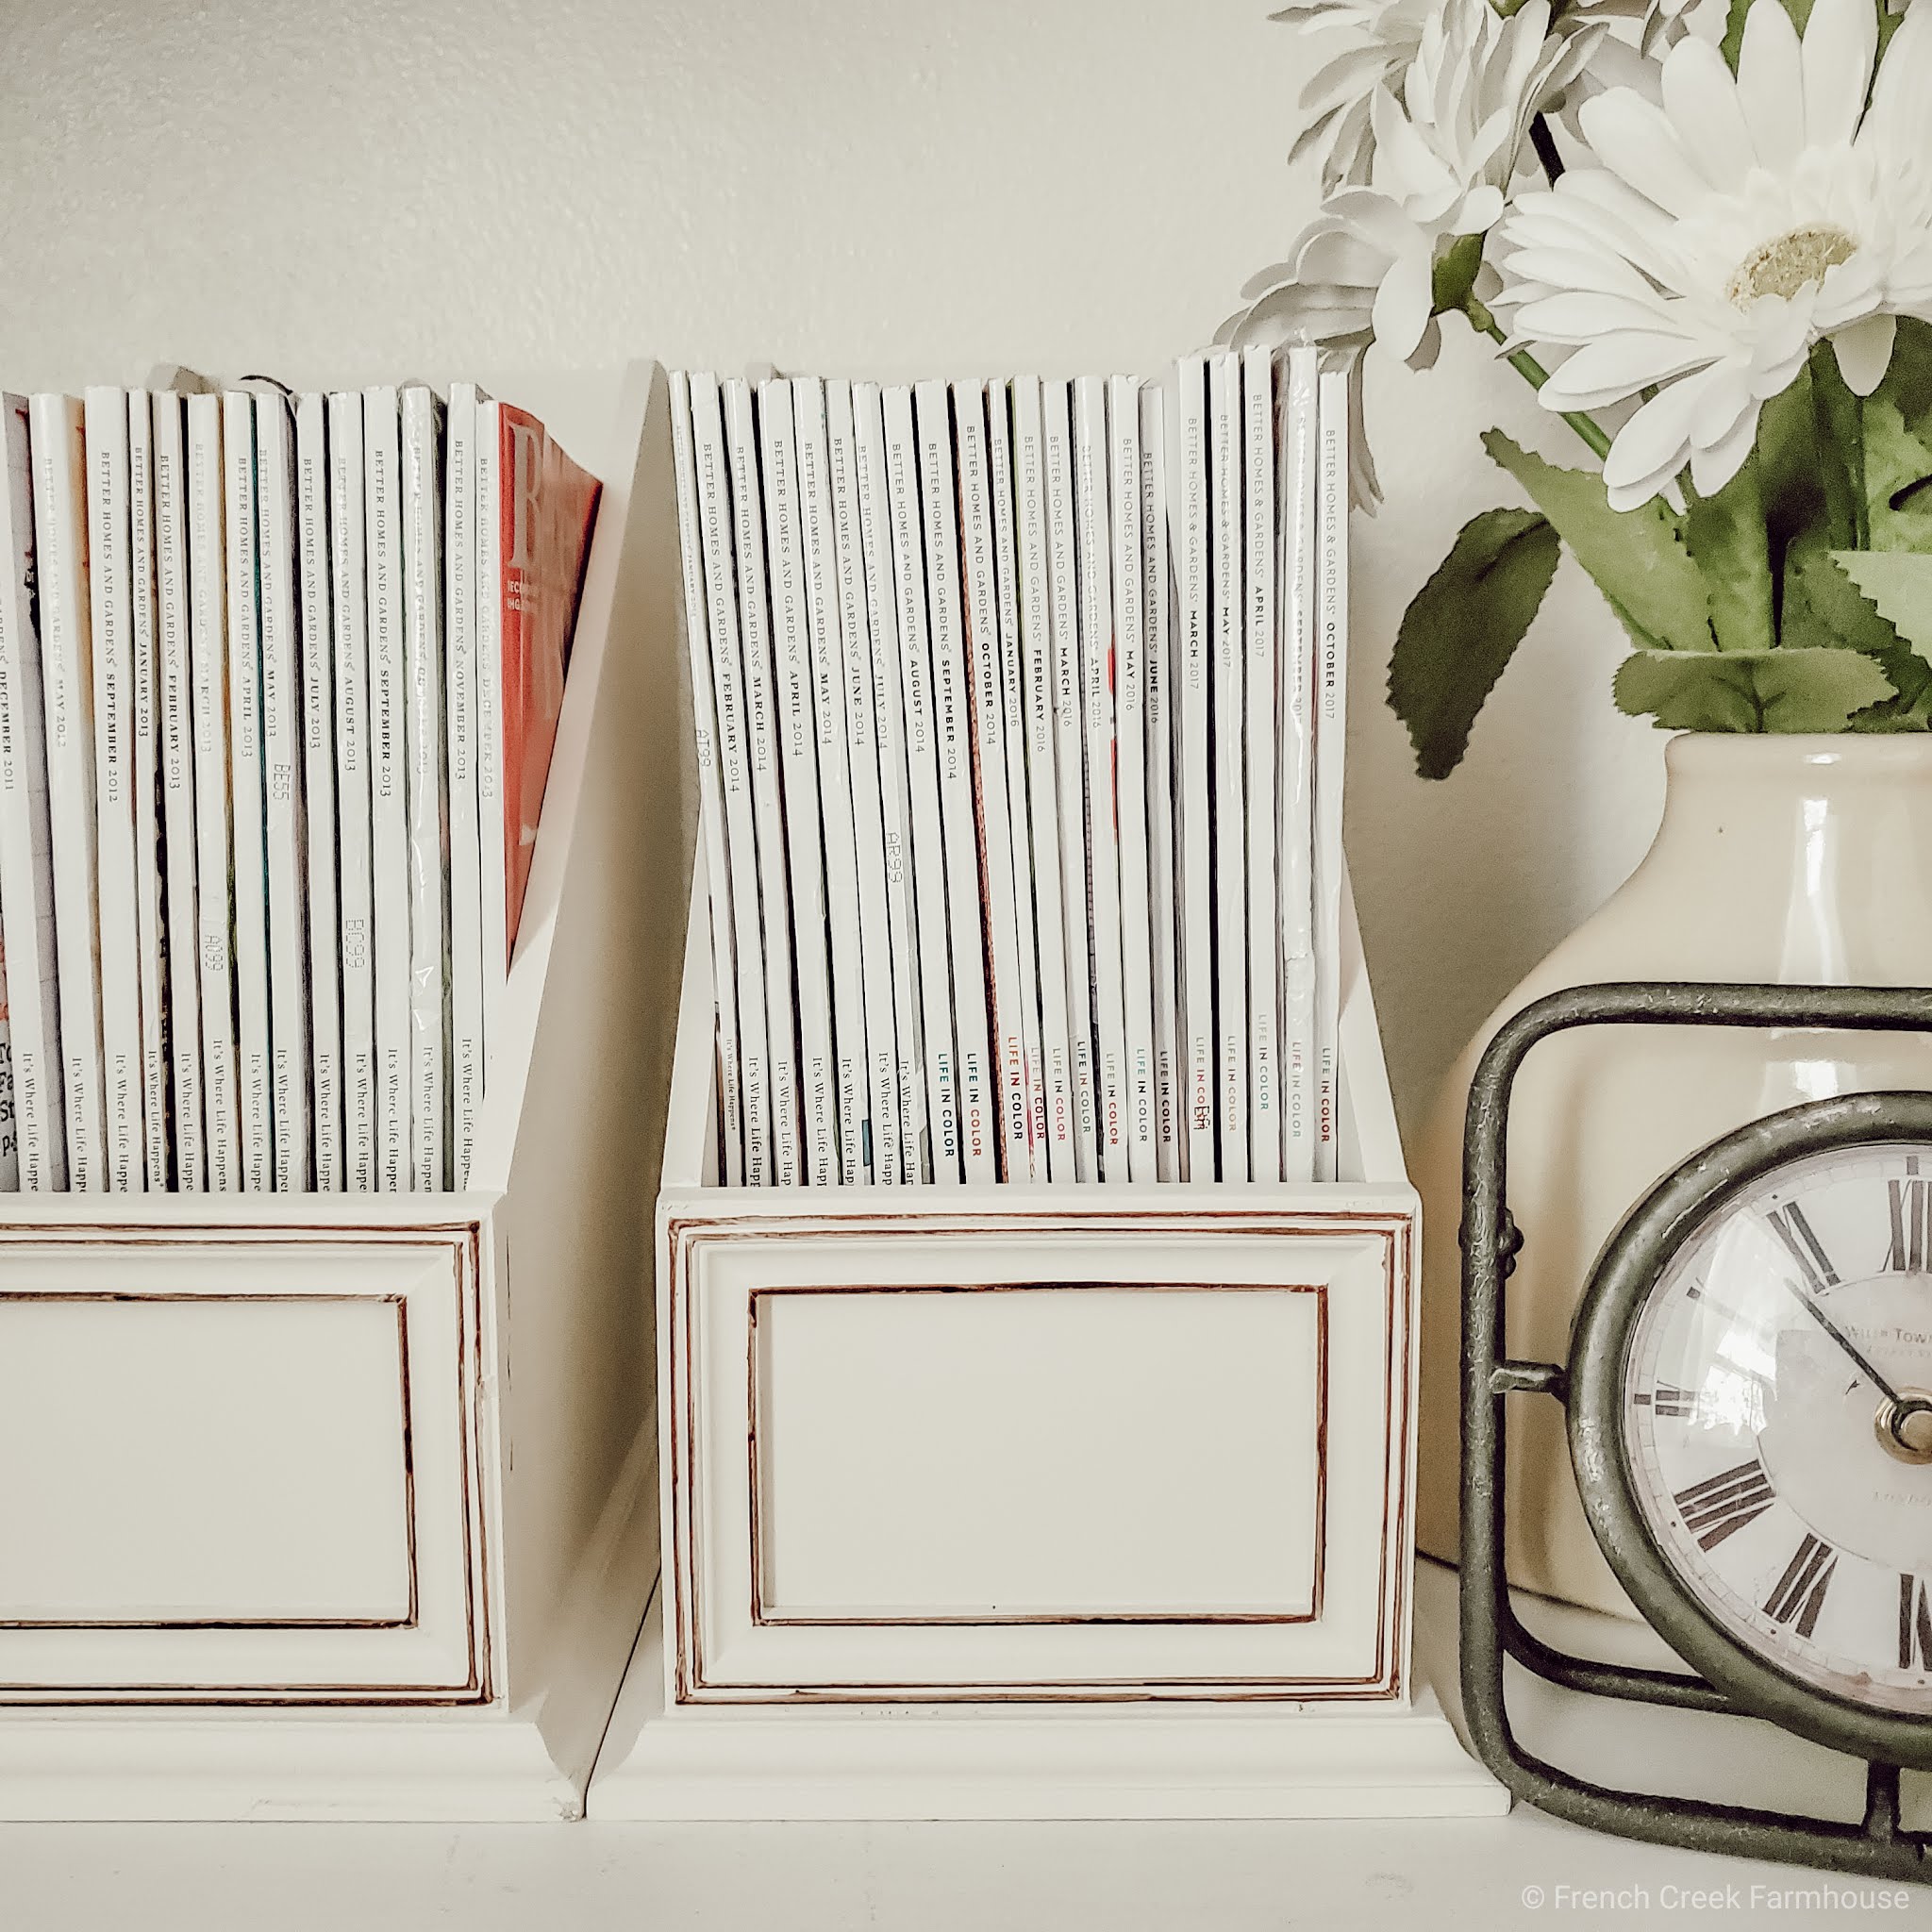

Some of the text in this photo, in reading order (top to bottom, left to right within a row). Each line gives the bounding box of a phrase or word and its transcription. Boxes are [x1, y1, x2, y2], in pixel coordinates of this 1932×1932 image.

[375, 450, 385, 504] BETTER
[455, 440, 463, 494] BETTER
[703, 443, 716, 500] BETTER
[774, 440, 786, 497] BETTER
[928, 442, 941, 494] BETTER
[966, 425, 978, 477] BETTER
[1123, 438, 1133, 486] BETTER
[1325, 429, 1336, 477] BETTER
[101, 452, 111, 506] BETTER
[159, 455, 170, 508] BETTER
[455, 499, 463, 548] HOMES
[708, 506, 721, 557] HOMES
[778, 503, 791, 554] HOMES
[932, 500, 943, 548] HOMES
[971, 483, 982, 530] HOMES
[1124, 491, 1134, 539] HOMES
[1325, 483, 1337, 531] HOMES
[102, 511, 112, 559] HOMES
[161, 513, 173, 562] HOMES
[376, 509, 386, 558] HOMES
[974, 536, 984, 564] AND
[1124, 544, 1134, 573] AND
[1326, 535, 1337, 544] &
[104, 565, 113, 594] AND
[164, 567, 174, 596] AND
[377, 562, 387, 591] AND
[455, 553, 464, 582] AND
[712, 561, 724, 591] AND
[782, 558, 792, 589] AND
[935, 554, 945, 581] AND
[1255, 586, 1265, 658] APRIL 2017
[981, 642, 993, 707] OCTOBER
[1126, 650, 1135, 678] MAY
[1190, 610, 1199, 690] MARCH 2017
[1222, 641, 1231, 668] 2017
[1325, 622, 1336, 687] OCTOBER
[139, 642, 149, 738] JANUARY 2013
[456, 659, 465, 743] NOVEMBER
[790, 671, 801, 717] APRIL
[851, 666, 865, 746] JUNE 2014
[910, 659, 925, 753] AUGUST 2014
[941, 659, 955, 741] SEPTEMBER
[1006, 633, 1020, 727] JANUARY 2016
[1033, 649, 1046, 753] FEBRUARY 2016
[1060, 647, 1073, 727] MARCH 2016
[1125, 683, 1136, 711] 2016
[1149, 659, 1159, 724] JUNE 2016
[1324, 692, 1335, 719] 2017
[107, 674, 117, 763] SEPTEMBER
[168, 675, 179, 753] FEBRUARY
[242, 676, 253, 758] APRIL 2013
[310, 676, 321, 749] JULY 2013
[344, 676, 357, 772] AUGUST 2013
[380, 670, 391, 759] SEPTEMBER
[723, 673, 737, 754] FEBRUARY
[753, 676, 767, 772] MARCH 2014
[820, 673, 833, 745] MAY 2014
[986, 713, 996, 745] 2014
[457, 748, 466, 780] 2013
[792, 723, 803, 757] 2014
[947, 748, 957, 779] 2014
[108, 770, 118, 803] 2012
[170, 758, 181, 790] 2013
[382, 765, 391, 797] 2013
[729, 759, 740, 792] 2014
[213, 1040, 224, 1060] It's
[115, 1055, 129, 1149] It's Where Life
[214, 1064, 225, 1106] Where
[320, 1054, 332, 1148] It's Where Life
[388, 1049, 399, 1143] It's Where Life
[748, 1057, 762, 1153] It's Where Life
[812, 1057, 828, 1153] It's Where Life
[938, 1053, 955, 1158] LIFE IN COLOR
[967, 1053, 982, 1157] LIFE IN COLOR
[1008, 1037, 1024, 1140] LIFE IN COLOR
[1052, 1047, 1066, 1141] LIFE IN COLOR
[1077, 1041, 1091, 1133] LIFE IN COLOR
[1136, 1048, 1148, 1141] LIFE IN COLOR
[1159, 1051, 1172, 1143] LIFE IN COLOR
[1321, 1047, 1331, 1142] LIFE IN COLOR
[216, 1110, 227, 1134] Life
[1761, 1532, 1839, 1638] VII
